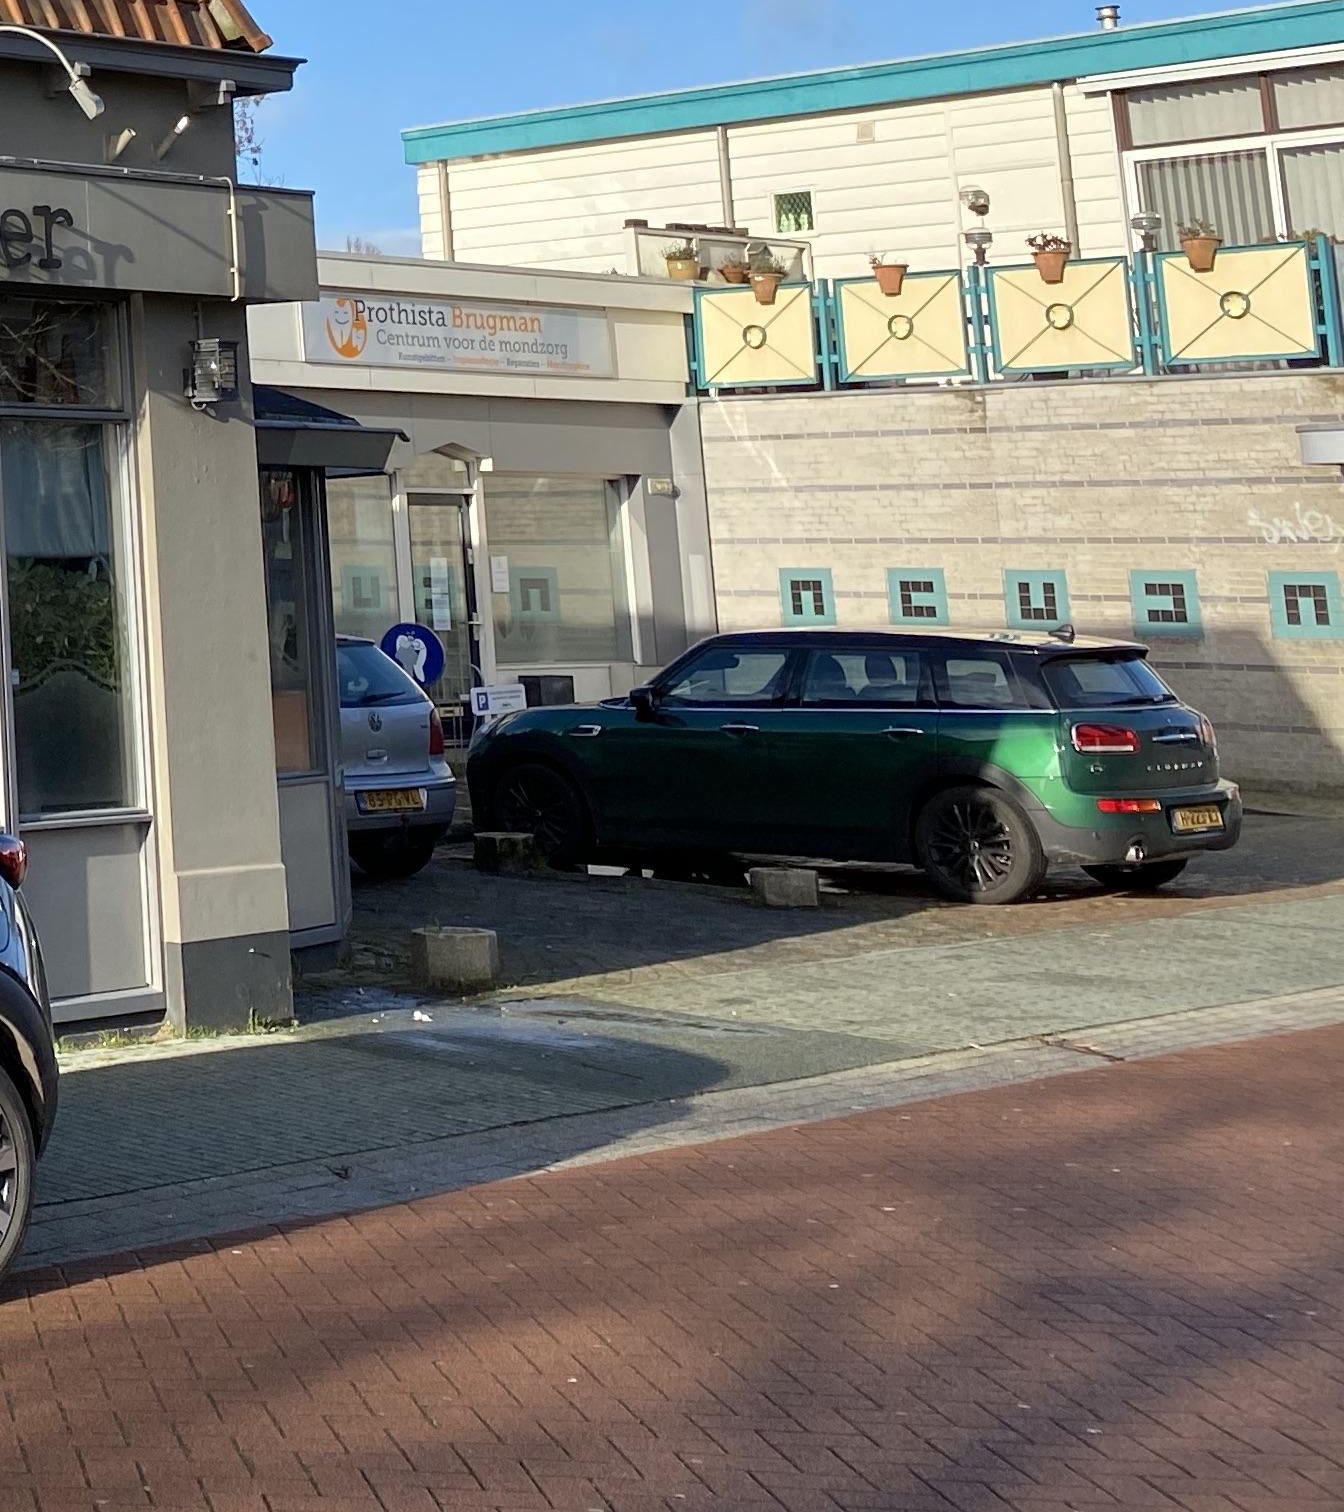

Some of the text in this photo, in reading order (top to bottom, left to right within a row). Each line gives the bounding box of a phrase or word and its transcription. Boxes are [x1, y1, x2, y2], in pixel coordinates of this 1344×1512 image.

[353, 299, 543, 336] Prothista Brugman
[376, 329, 569, 360] Centrum voor de mondzorg
